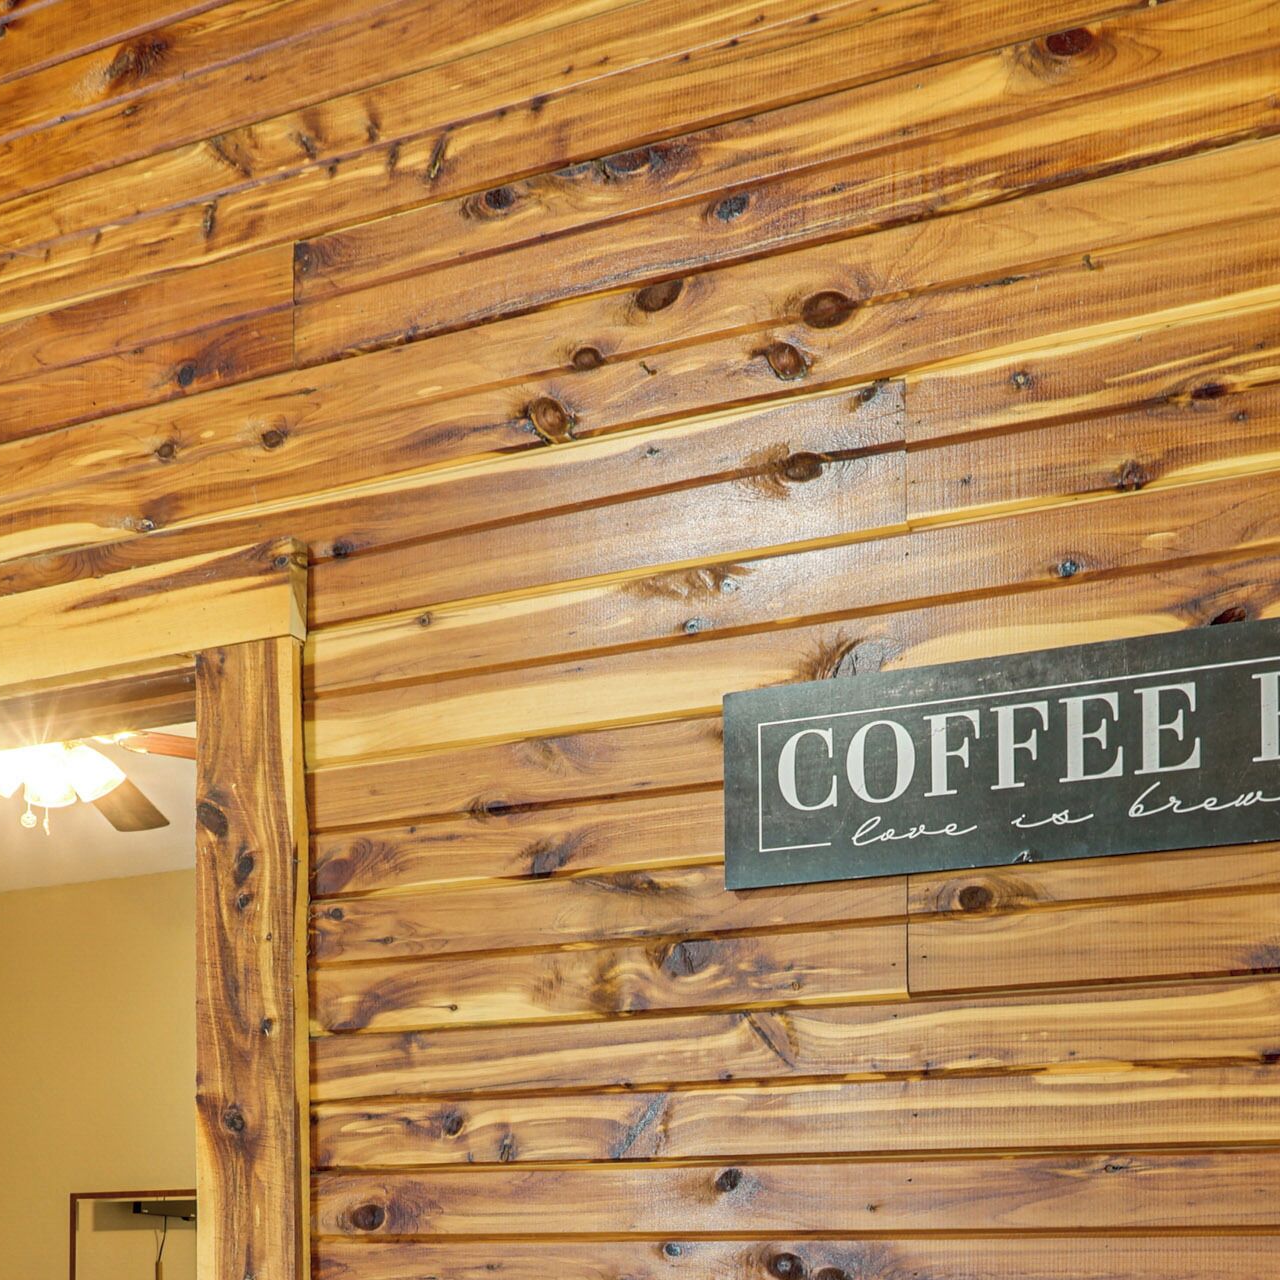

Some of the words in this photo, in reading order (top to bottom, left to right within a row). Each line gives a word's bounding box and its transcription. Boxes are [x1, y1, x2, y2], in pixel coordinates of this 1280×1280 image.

[776, 681, 1203, 812] COFFEE
[851, 815, 980, 848] love
[1011, 806, 1094, 829] is
